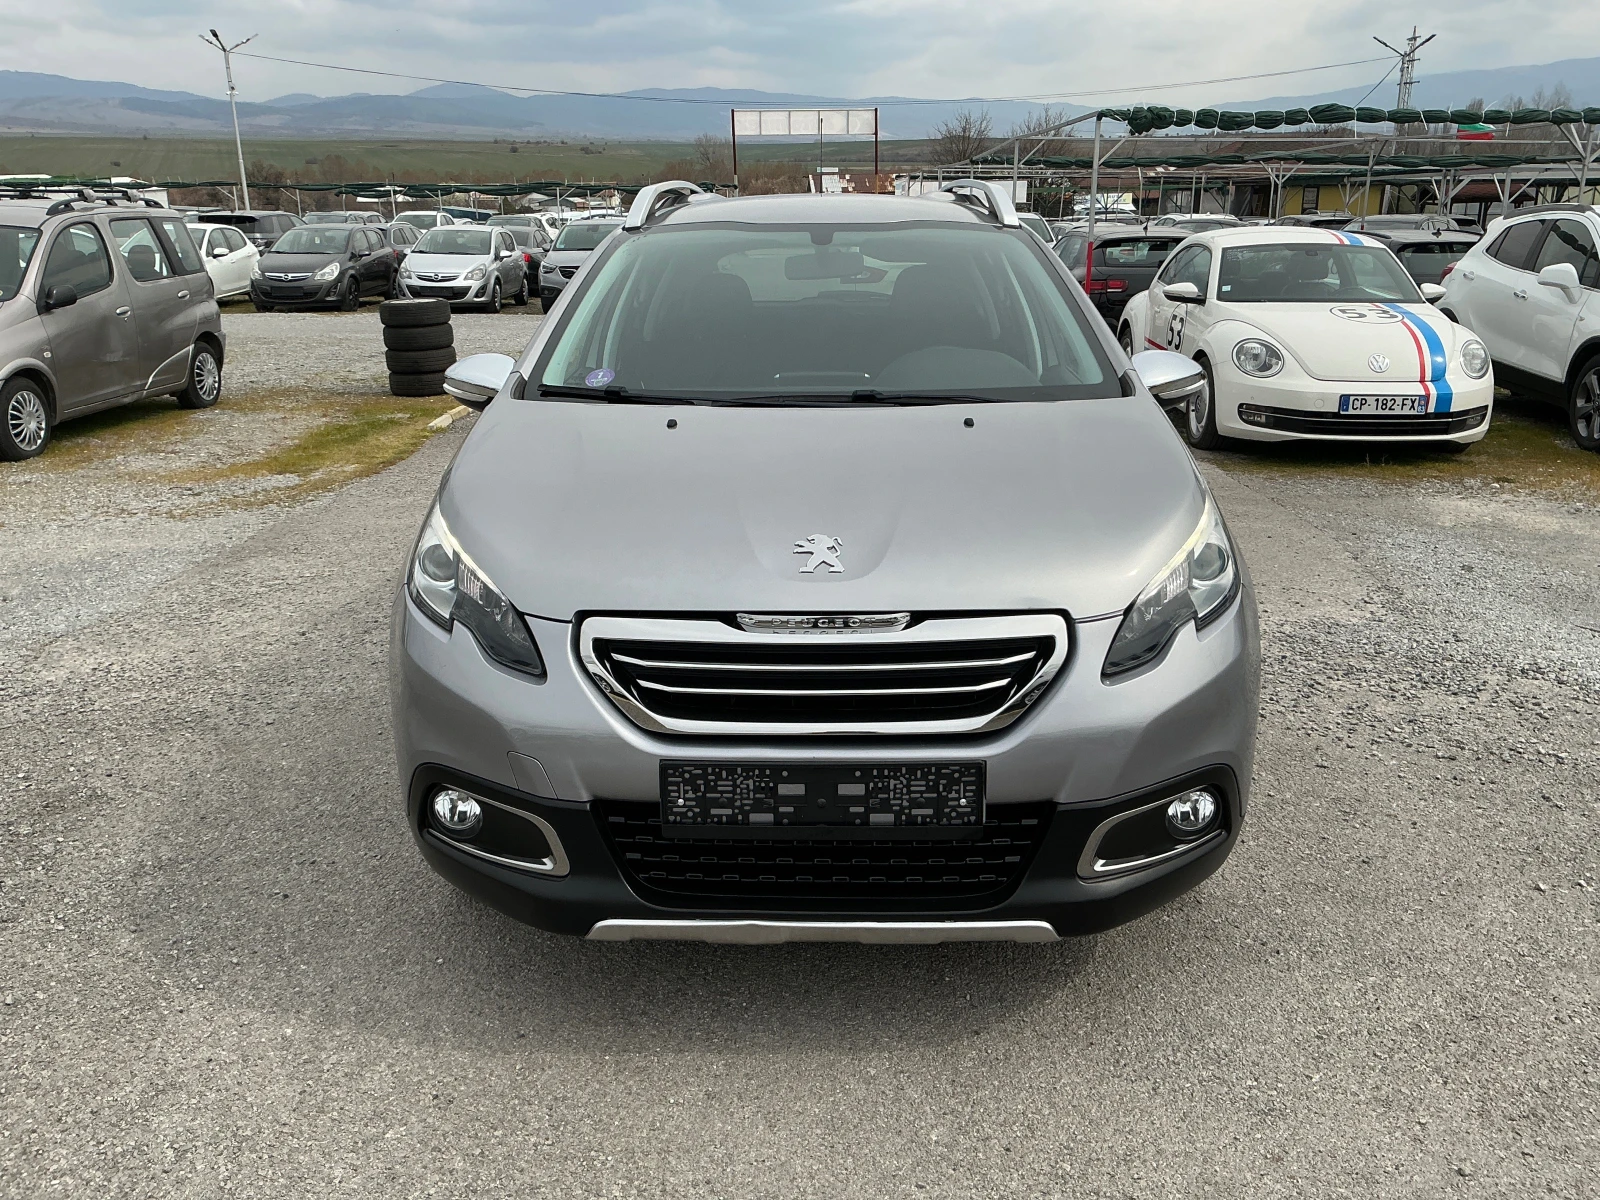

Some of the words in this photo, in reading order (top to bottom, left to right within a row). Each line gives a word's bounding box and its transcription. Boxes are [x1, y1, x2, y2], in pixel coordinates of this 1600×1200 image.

[1337, 308, 1399, 319] 53
[1168, 314, 1184, 350] 53
[771, 617, 877, 627] PEUGEOT
